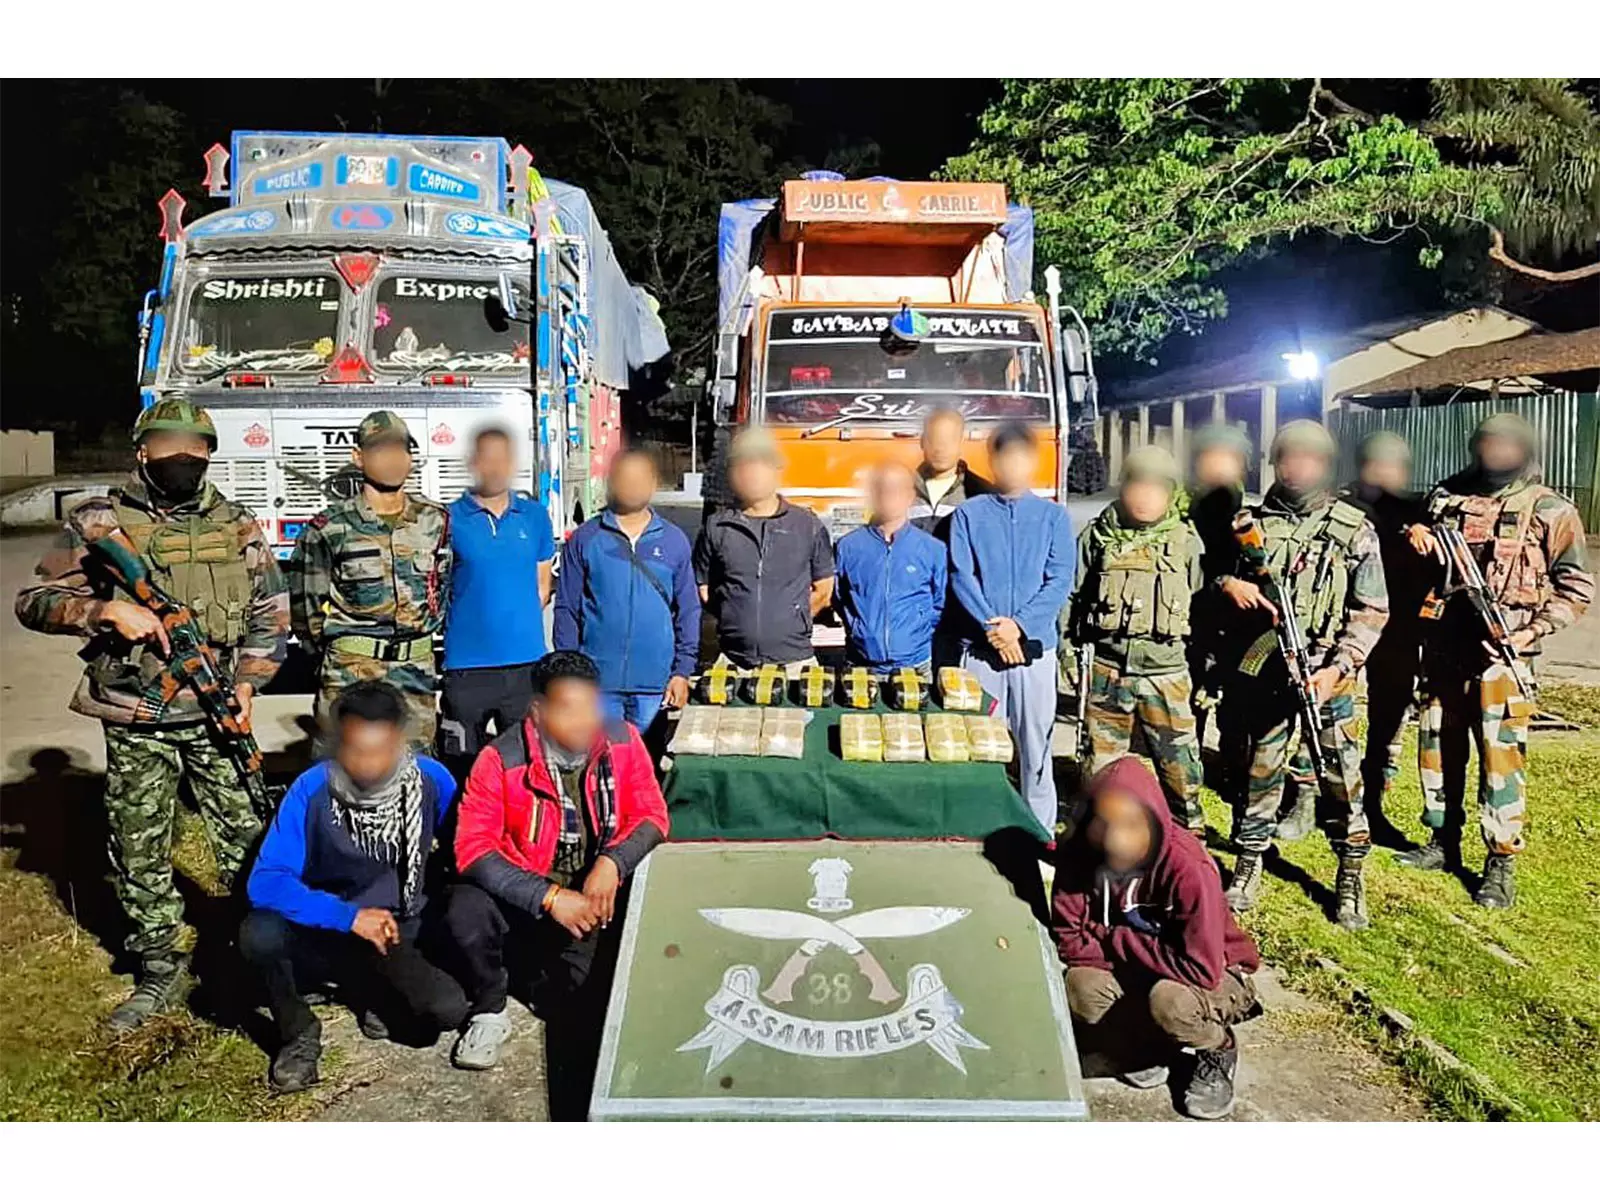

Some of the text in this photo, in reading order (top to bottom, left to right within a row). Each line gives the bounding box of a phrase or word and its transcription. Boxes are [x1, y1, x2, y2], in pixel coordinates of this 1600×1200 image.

[266, 167, 311, 189] PUBLIC
[918, 194, 997, 214] CARRIE
[203, 277, 520, 300] Shrishti Expre
[792, 315, 1021, 336] JAYBAB OKNATH
[807, 972, 852, 1005] 38
[721, 999, 937, 1053] ASSAM RIFLES
